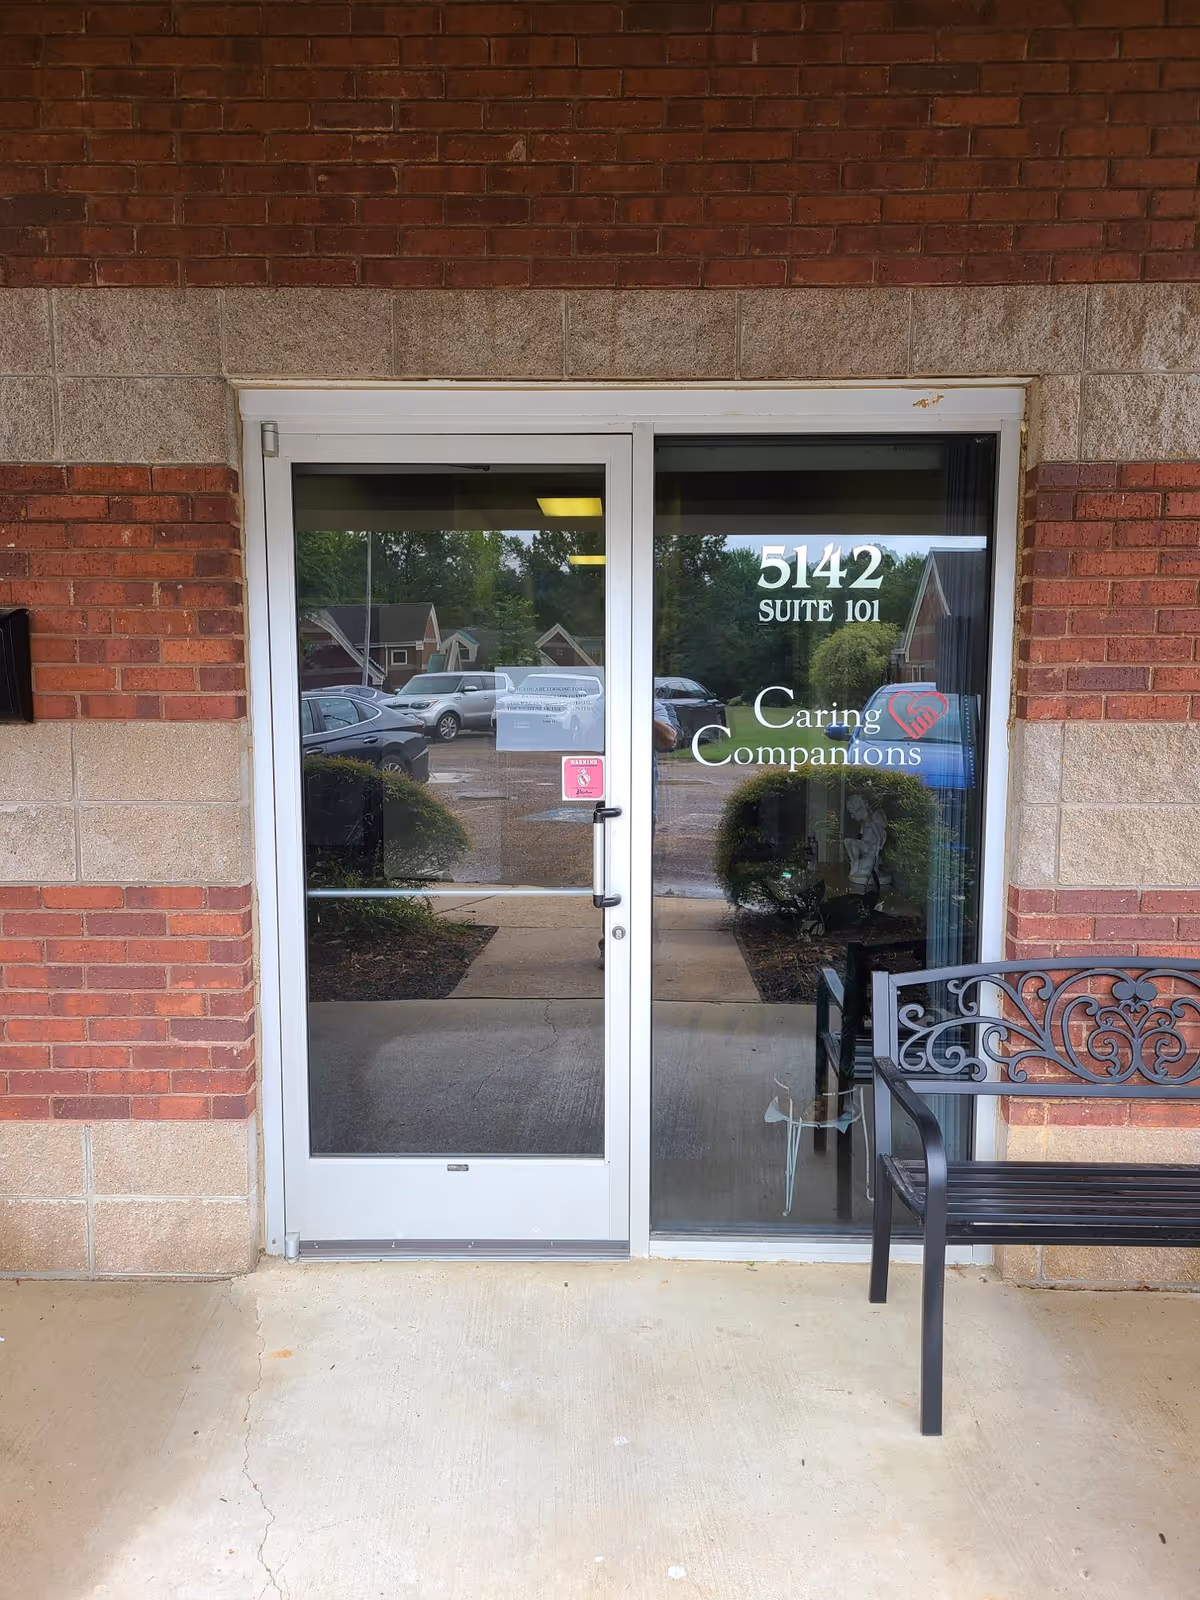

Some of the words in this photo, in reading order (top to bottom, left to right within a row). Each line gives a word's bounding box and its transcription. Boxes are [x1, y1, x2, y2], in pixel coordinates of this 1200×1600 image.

[757, 542, 884, 590] 5142
[758, 599, 834, 622] SUITE
[845, 599, 881, 622] 101
[754, 686, 882, 734] Caring
[691, 724, 922, 773] Companions
